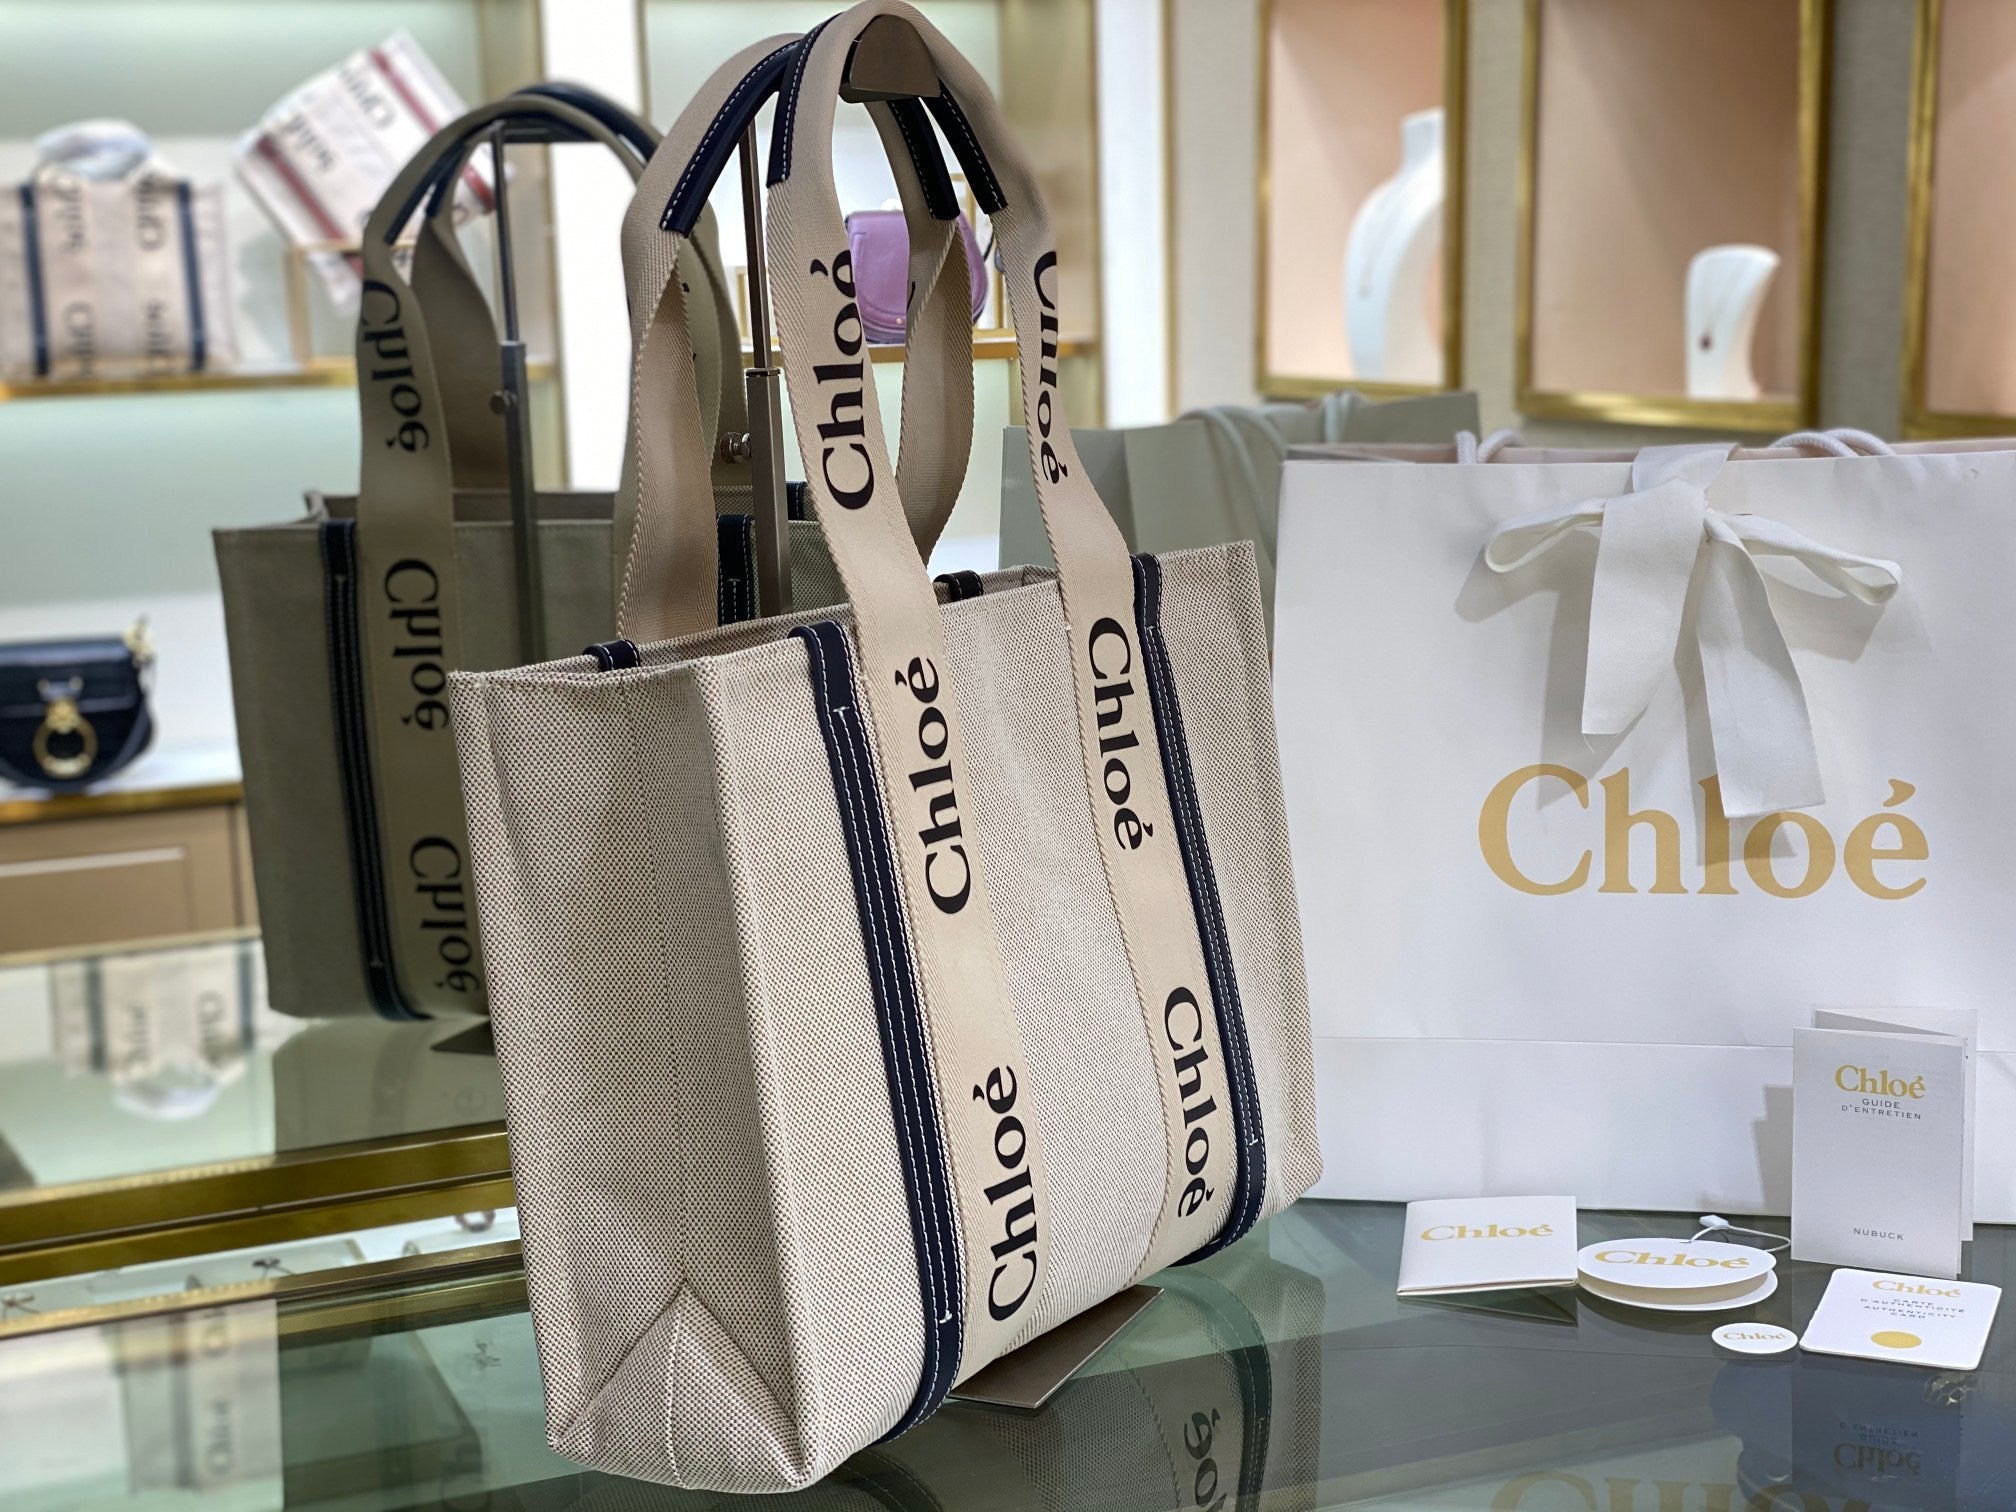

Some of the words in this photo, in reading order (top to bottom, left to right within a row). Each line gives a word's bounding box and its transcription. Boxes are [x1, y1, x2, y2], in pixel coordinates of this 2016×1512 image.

[810, 250, 874, 510] Chloé
[1088, 617, 1153, 851] Chloé
[895, 656, 971, 915] Chloé
[1478, 763, 1929, 900] Chloé
[1835, 1064, 1926, 1099] Chloé
[1164, 987, 1217, 1219] Chloé
[1841, 1104, 1922, 1120] D'ENTRETIEN
[1862, 1098, 1901, 1109] GUIDE
[973, 1065, 1038, 1322] Chloé
[1420, 1223, 1554, 1241] Chloé
[1853, 1227, 1904, 1241] NUBUCK
[1594, 1250, 1750, 1269] Chloé
[1872, 1280, 1962, 1298] Chloé
[1723, 1332, 1786, 1340] Chloé
